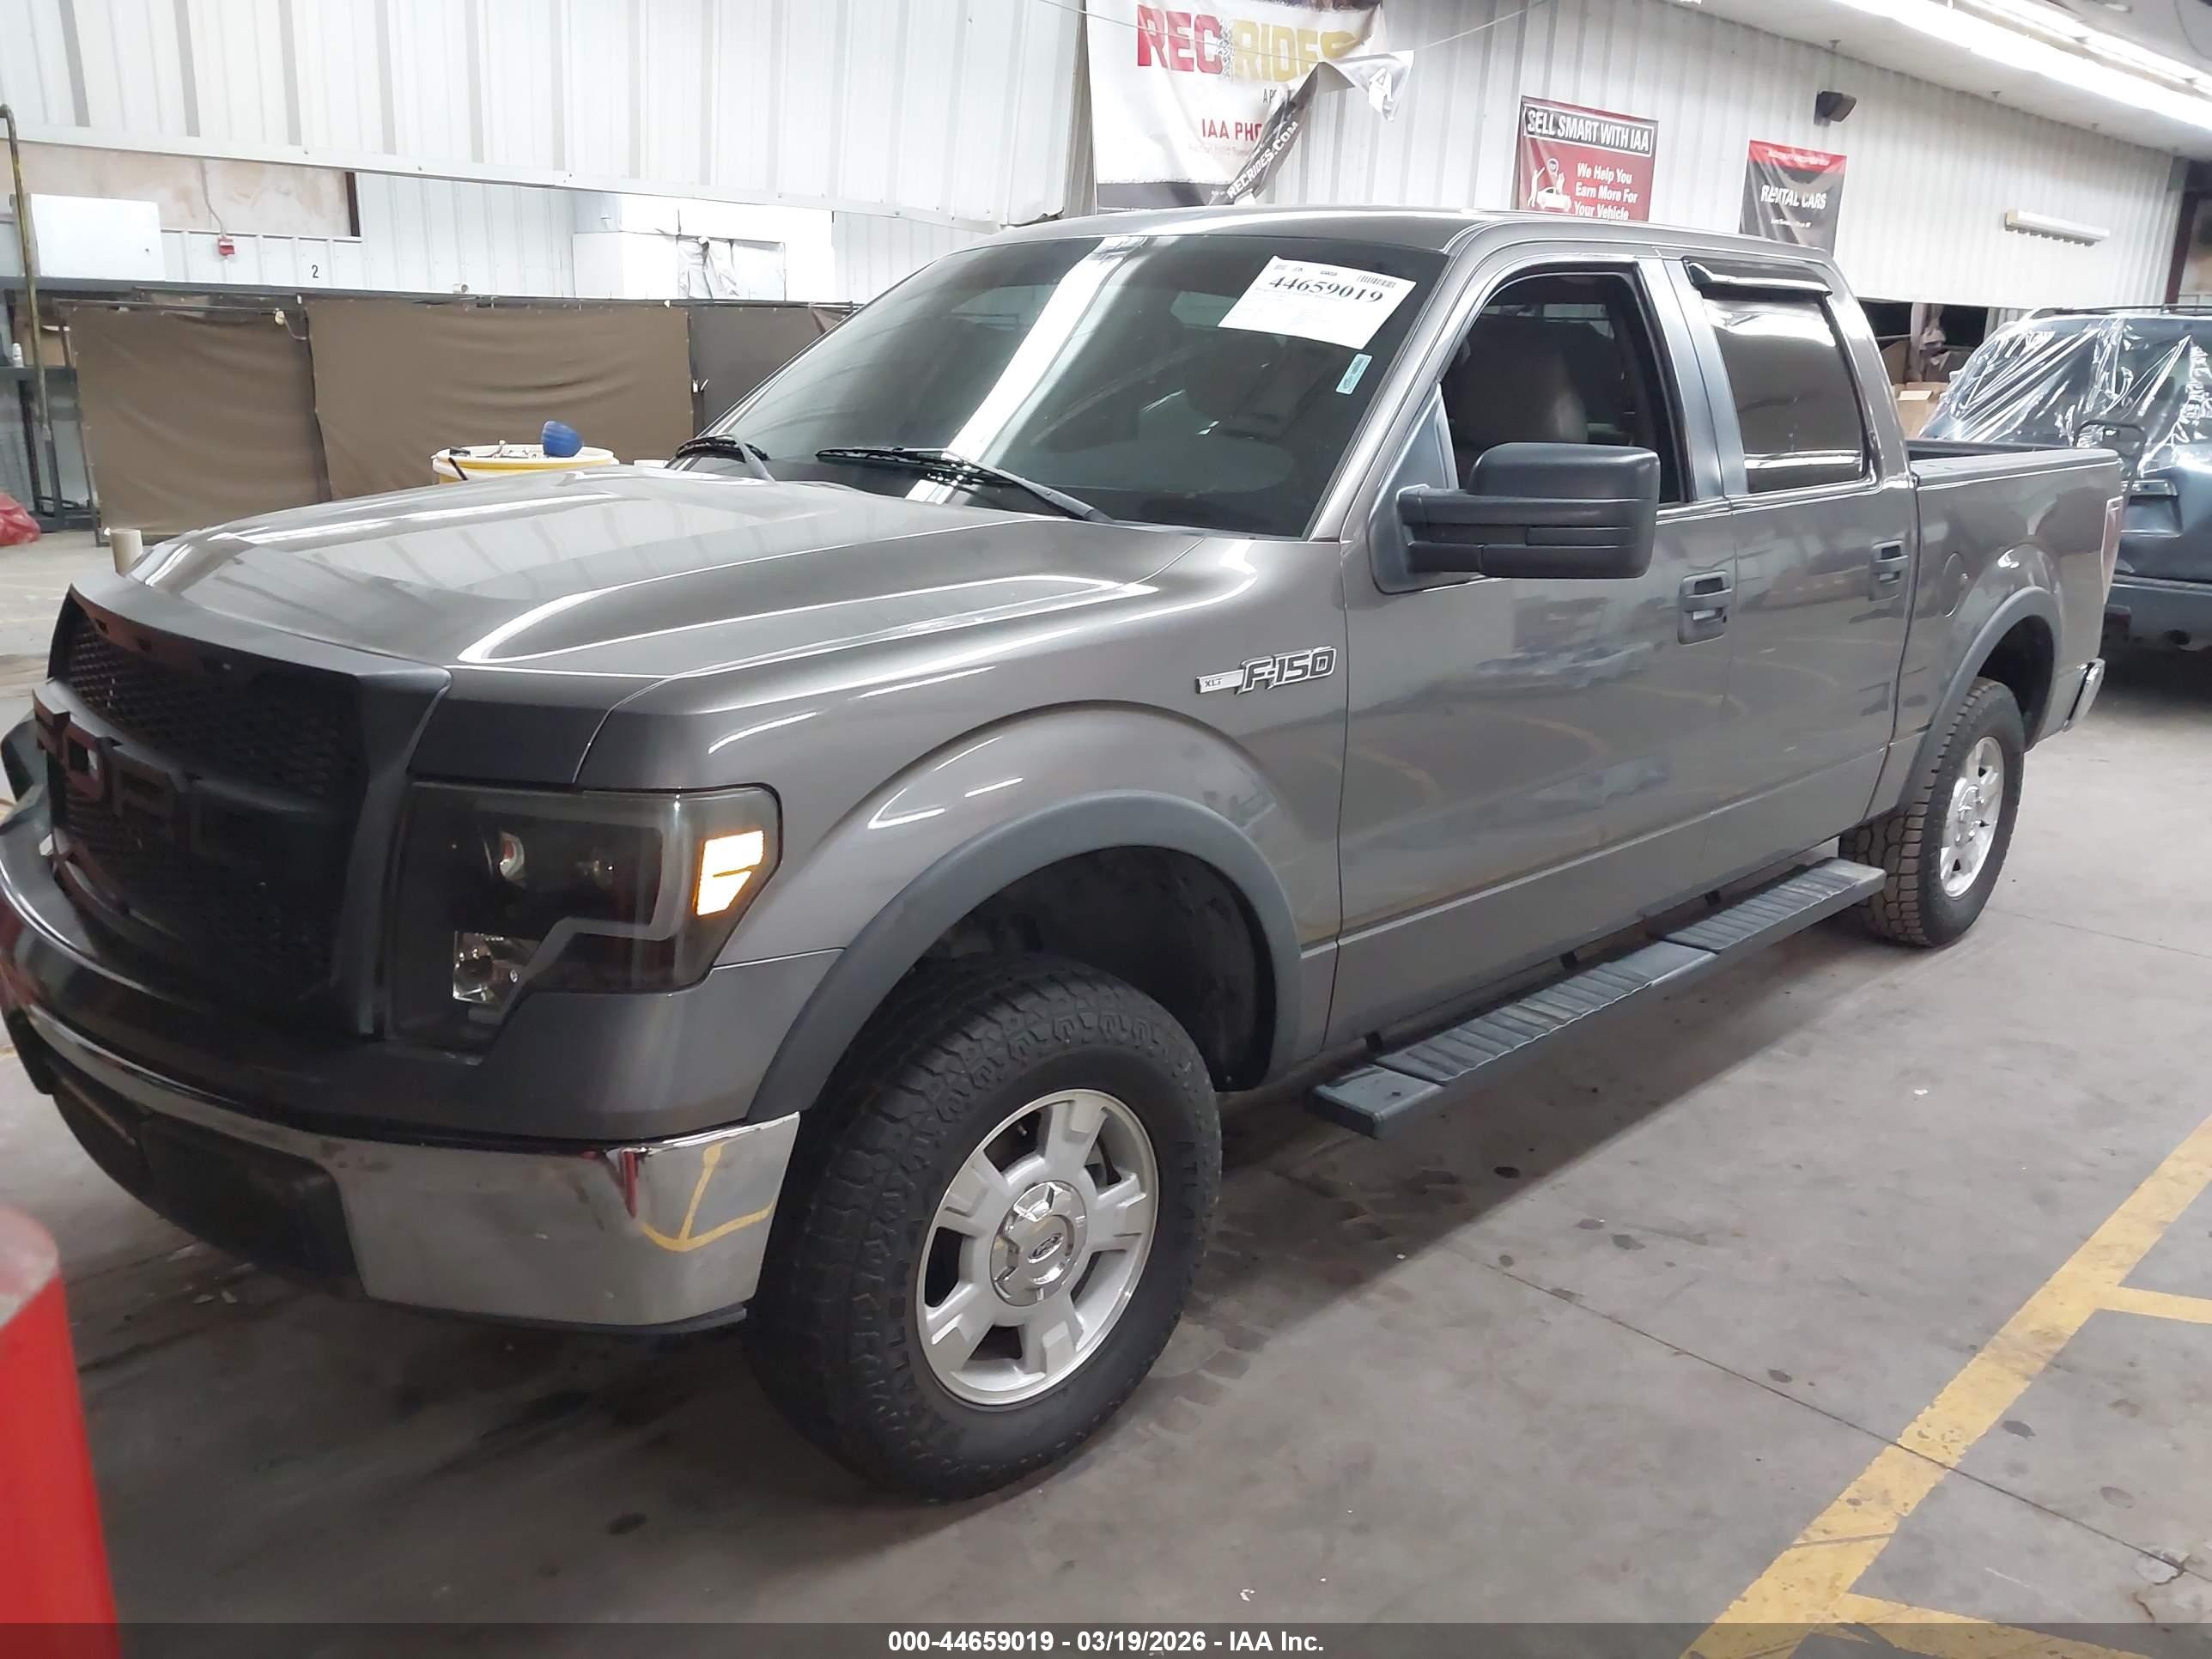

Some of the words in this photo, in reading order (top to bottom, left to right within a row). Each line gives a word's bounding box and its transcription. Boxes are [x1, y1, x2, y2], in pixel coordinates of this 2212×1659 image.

[1202, 118, 1230, 139] IAA
[1527, 110, 1555, 136] SELL
[1558, 115, 1598, 143] SMART
[1601, 124, 1629, 148] WITH
[1630, 130, 1650, 151] IAA
[1227, 121, 1298, 199] RECRIDES.COM
[1577, 162, 1592, 179] We
[1594, 165, 1615, 184] Help
[1616, 168, 1632, 185] You
[1576, 182, 1597, 198] Earn
[1598, 185, 1621, 202] More
[1623, 188, 1638, 204] For
[1760, 185, 1800, 207] RENTAL
[1801, 192, 1827, 210] CARS
[1574, 201, 1595, 216] Your
[1596, 203, 1629, 221] Vehicle
[311, 264, 319, 279] 2
[1268, 276, 1384, 303] 44659019
[1205, 678, 1223, 688] XLT
[1239, 646, 1337, 694] F-150
